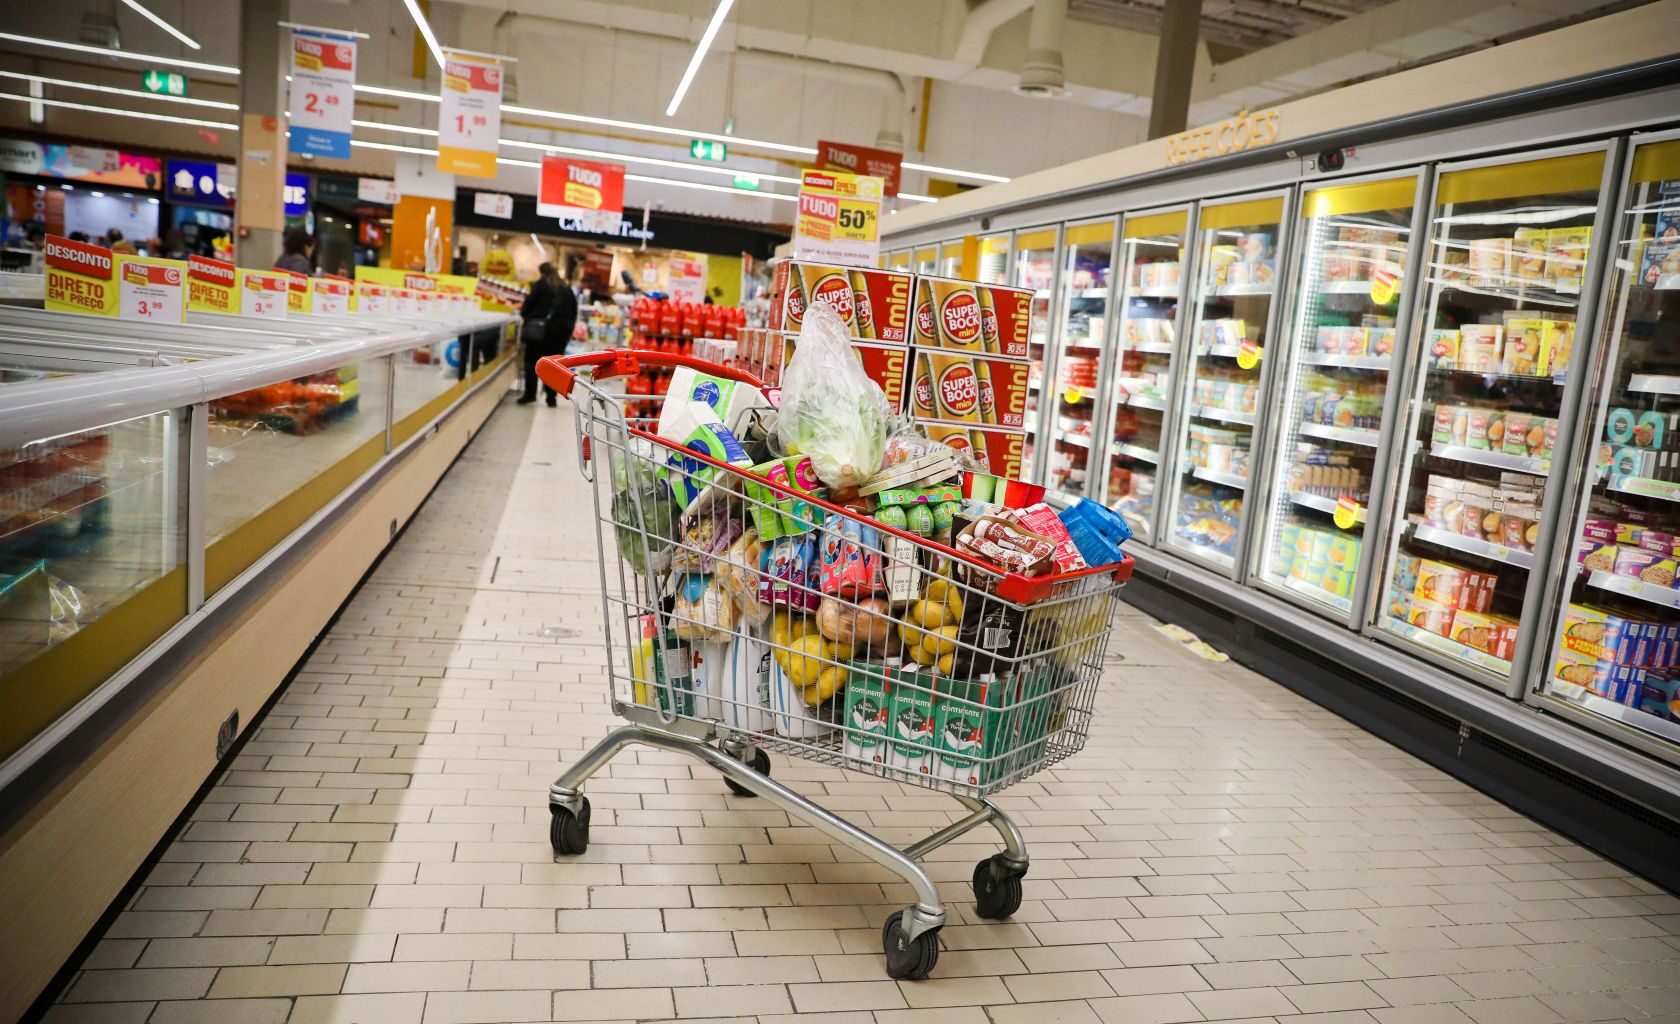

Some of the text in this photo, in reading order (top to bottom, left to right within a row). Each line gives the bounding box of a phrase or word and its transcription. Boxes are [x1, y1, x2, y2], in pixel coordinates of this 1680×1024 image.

[1167, 109, 1280, 164] REFEIÇÕES
[827, 147, 857, 167] TUDO
[567, 165, 602, 187] TUDO
[801, 195, 836, 219] TUDO
[47, 243, 111, 270] DESCONTO
[189, 261, 234, 280] DESCONTO
[49, 273, 104, 299] DIRETO
[816, 287, 852, 305] SUPER
[48, 288, 105, 311] EM PREÇO
[886, 275, 909, 328] mini
[945, 303, 979, 320] SUPER
[1011, 292, 1032, 343] mini
[949, 315, 979, 331] BOCK
[958, 328, 975, 338] mini
[881, 349, 904, 401] mini
[943, 375, 976, 392] SUPER
[947, 387, 976, 403] BOCK
[1007, 364, 1029, 414] mini
[955, 399, 972, 410] mini
